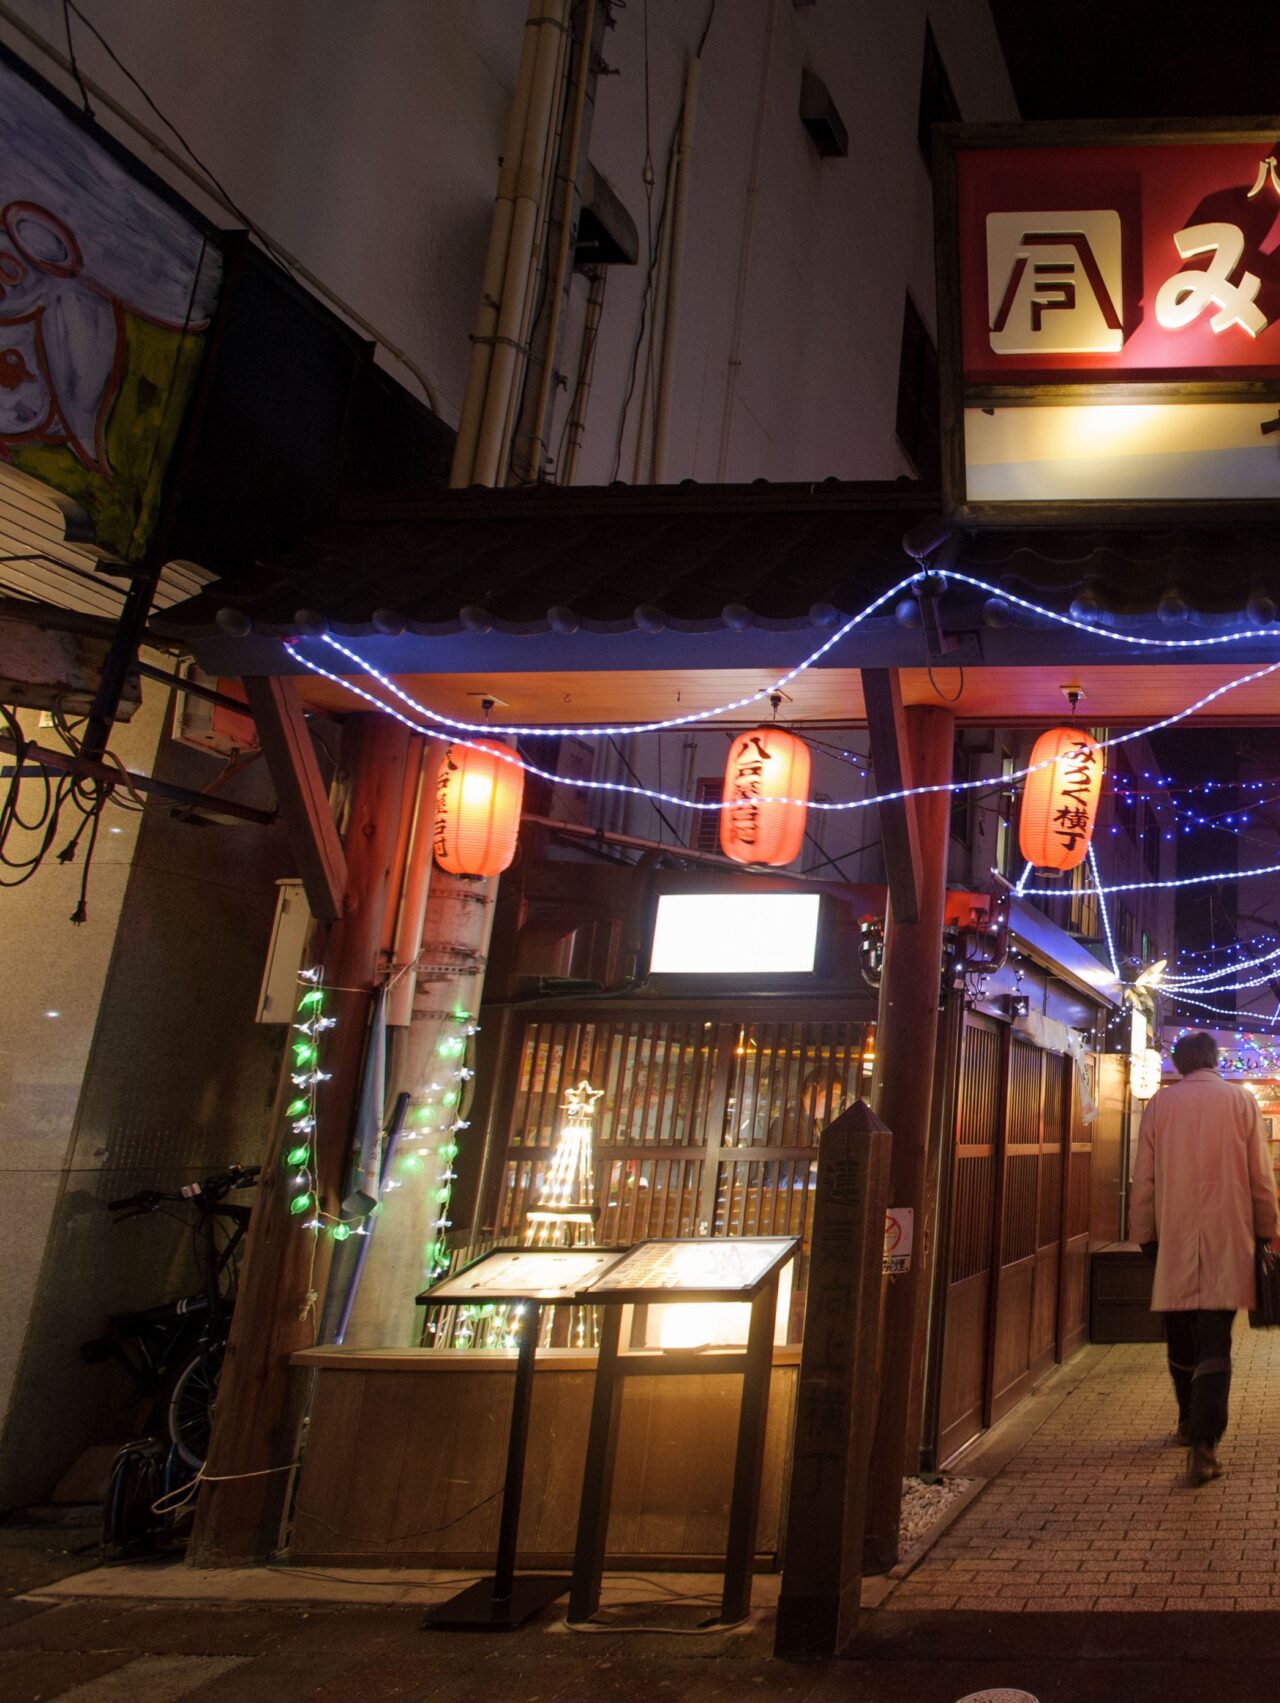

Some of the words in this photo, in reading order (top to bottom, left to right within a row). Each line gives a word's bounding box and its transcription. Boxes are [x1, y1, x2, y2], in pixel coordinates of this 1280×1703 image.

[1053, 741, 1097, 851] みろく横丁
